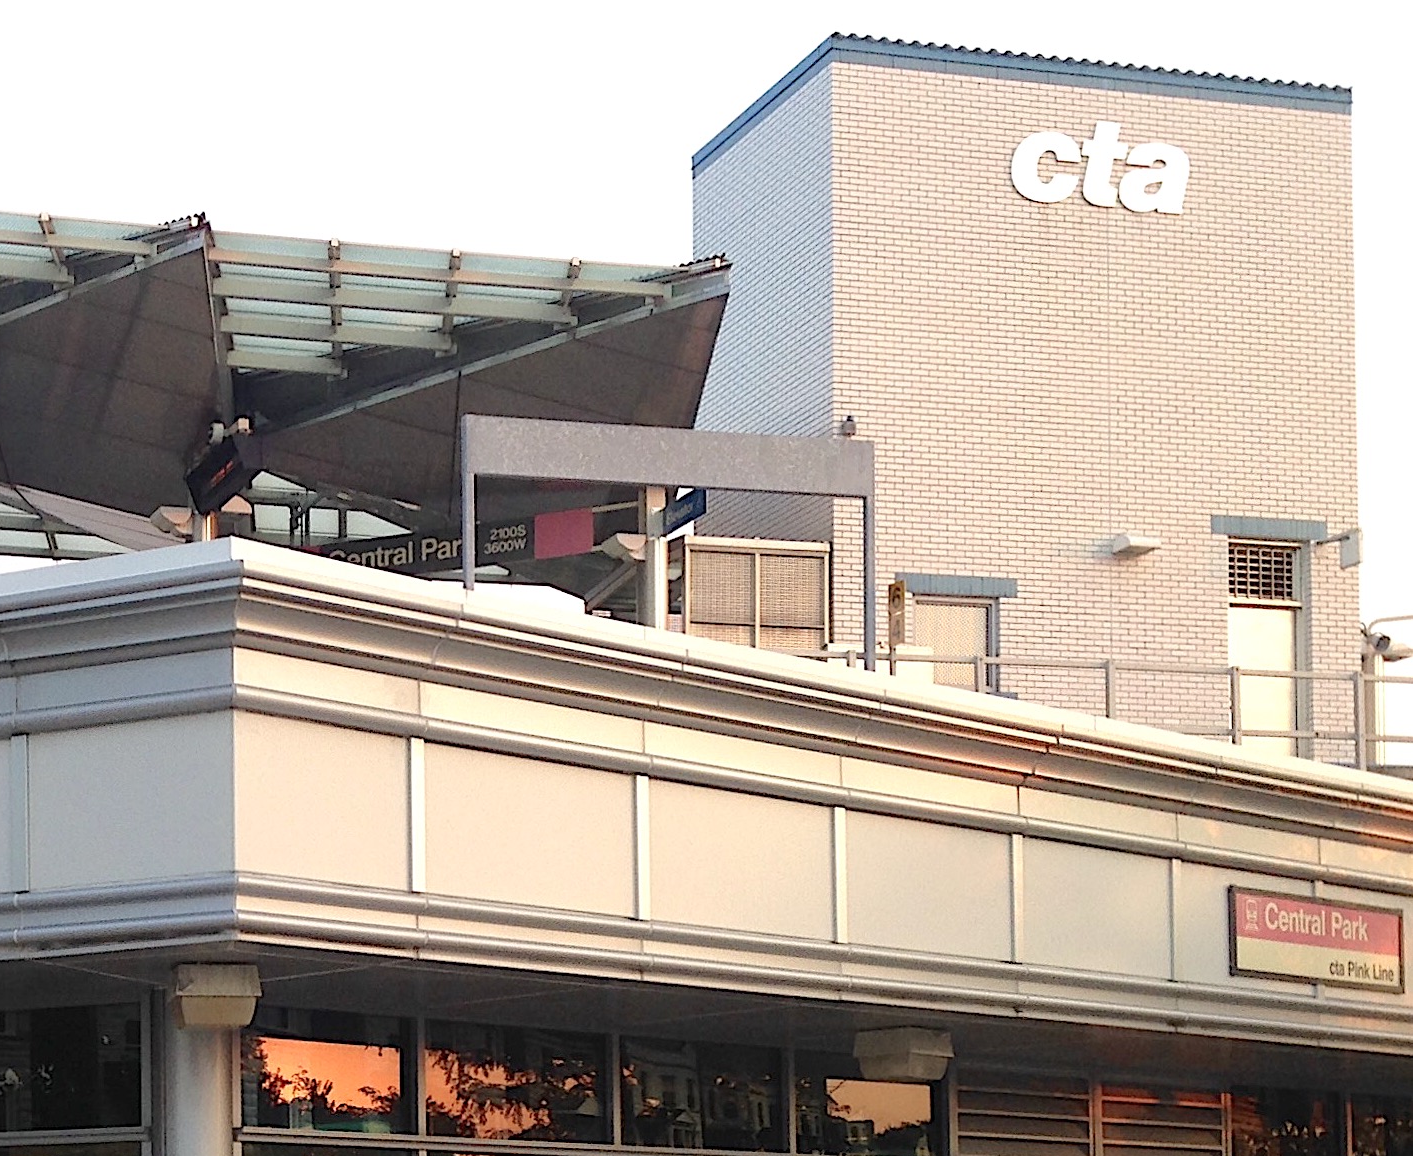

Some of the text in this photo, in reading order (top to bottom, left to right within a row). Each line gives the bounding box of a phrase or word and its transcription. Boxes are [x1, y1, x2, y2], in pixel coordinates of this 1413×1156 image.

[1011, 120, 1190, 215] cta
[489, 524, 527, 541] 2100S
[421, 537, 463, 561] Par
[484, 538, 527, 555] 3600W
[1264, 902, 1369, 941] Central Park
[1329, 960, 1395, 983] cta Pink Line
